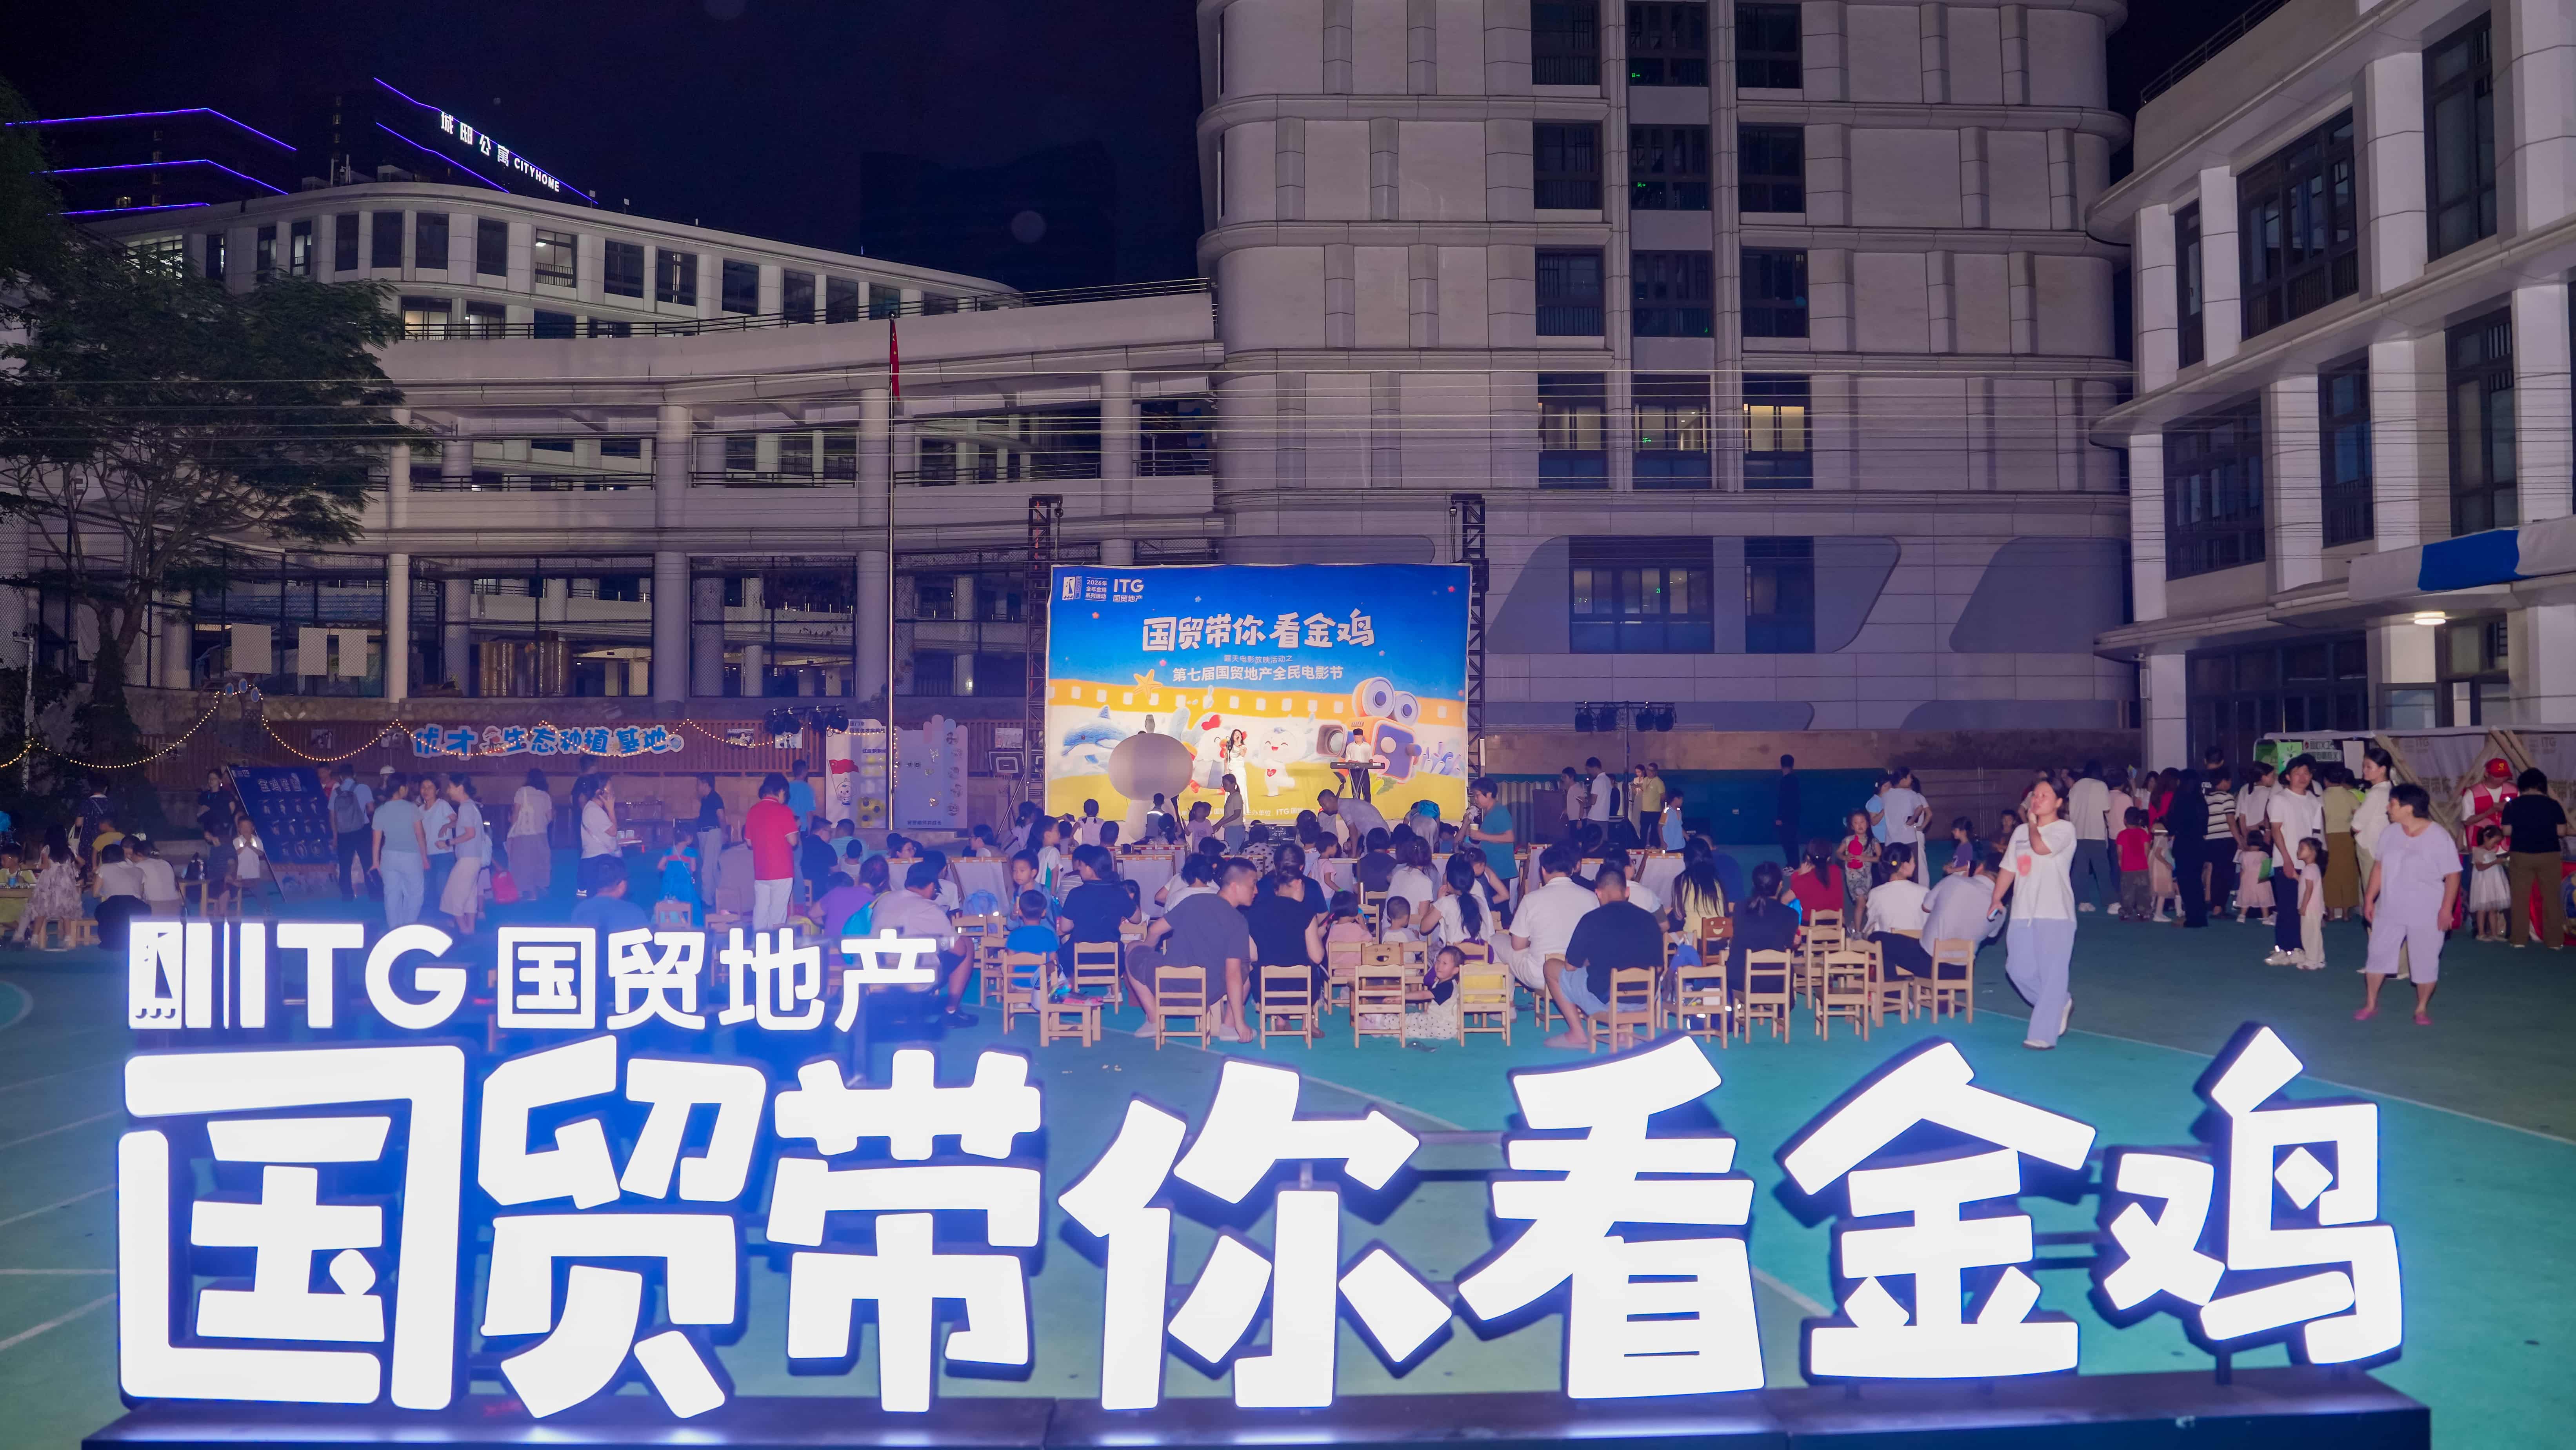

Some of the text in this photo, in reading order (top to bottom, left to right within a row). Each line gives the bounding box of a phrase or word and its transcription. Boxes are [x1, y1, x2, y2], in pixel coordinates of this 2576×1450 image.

[514, 158, 559, 192] CITYHOME
[1113, 579, 1144, 593] ITG
[1224, 654, 1293, 663] 露天电影放映活动之
[1173, 665, 1343, 682] 第七届国贸地产全民电影节
[240, 922, 937, 1032] ITG 国贸地产
[118, 1026, 2403, 1418] 国贸带你看金鸡
